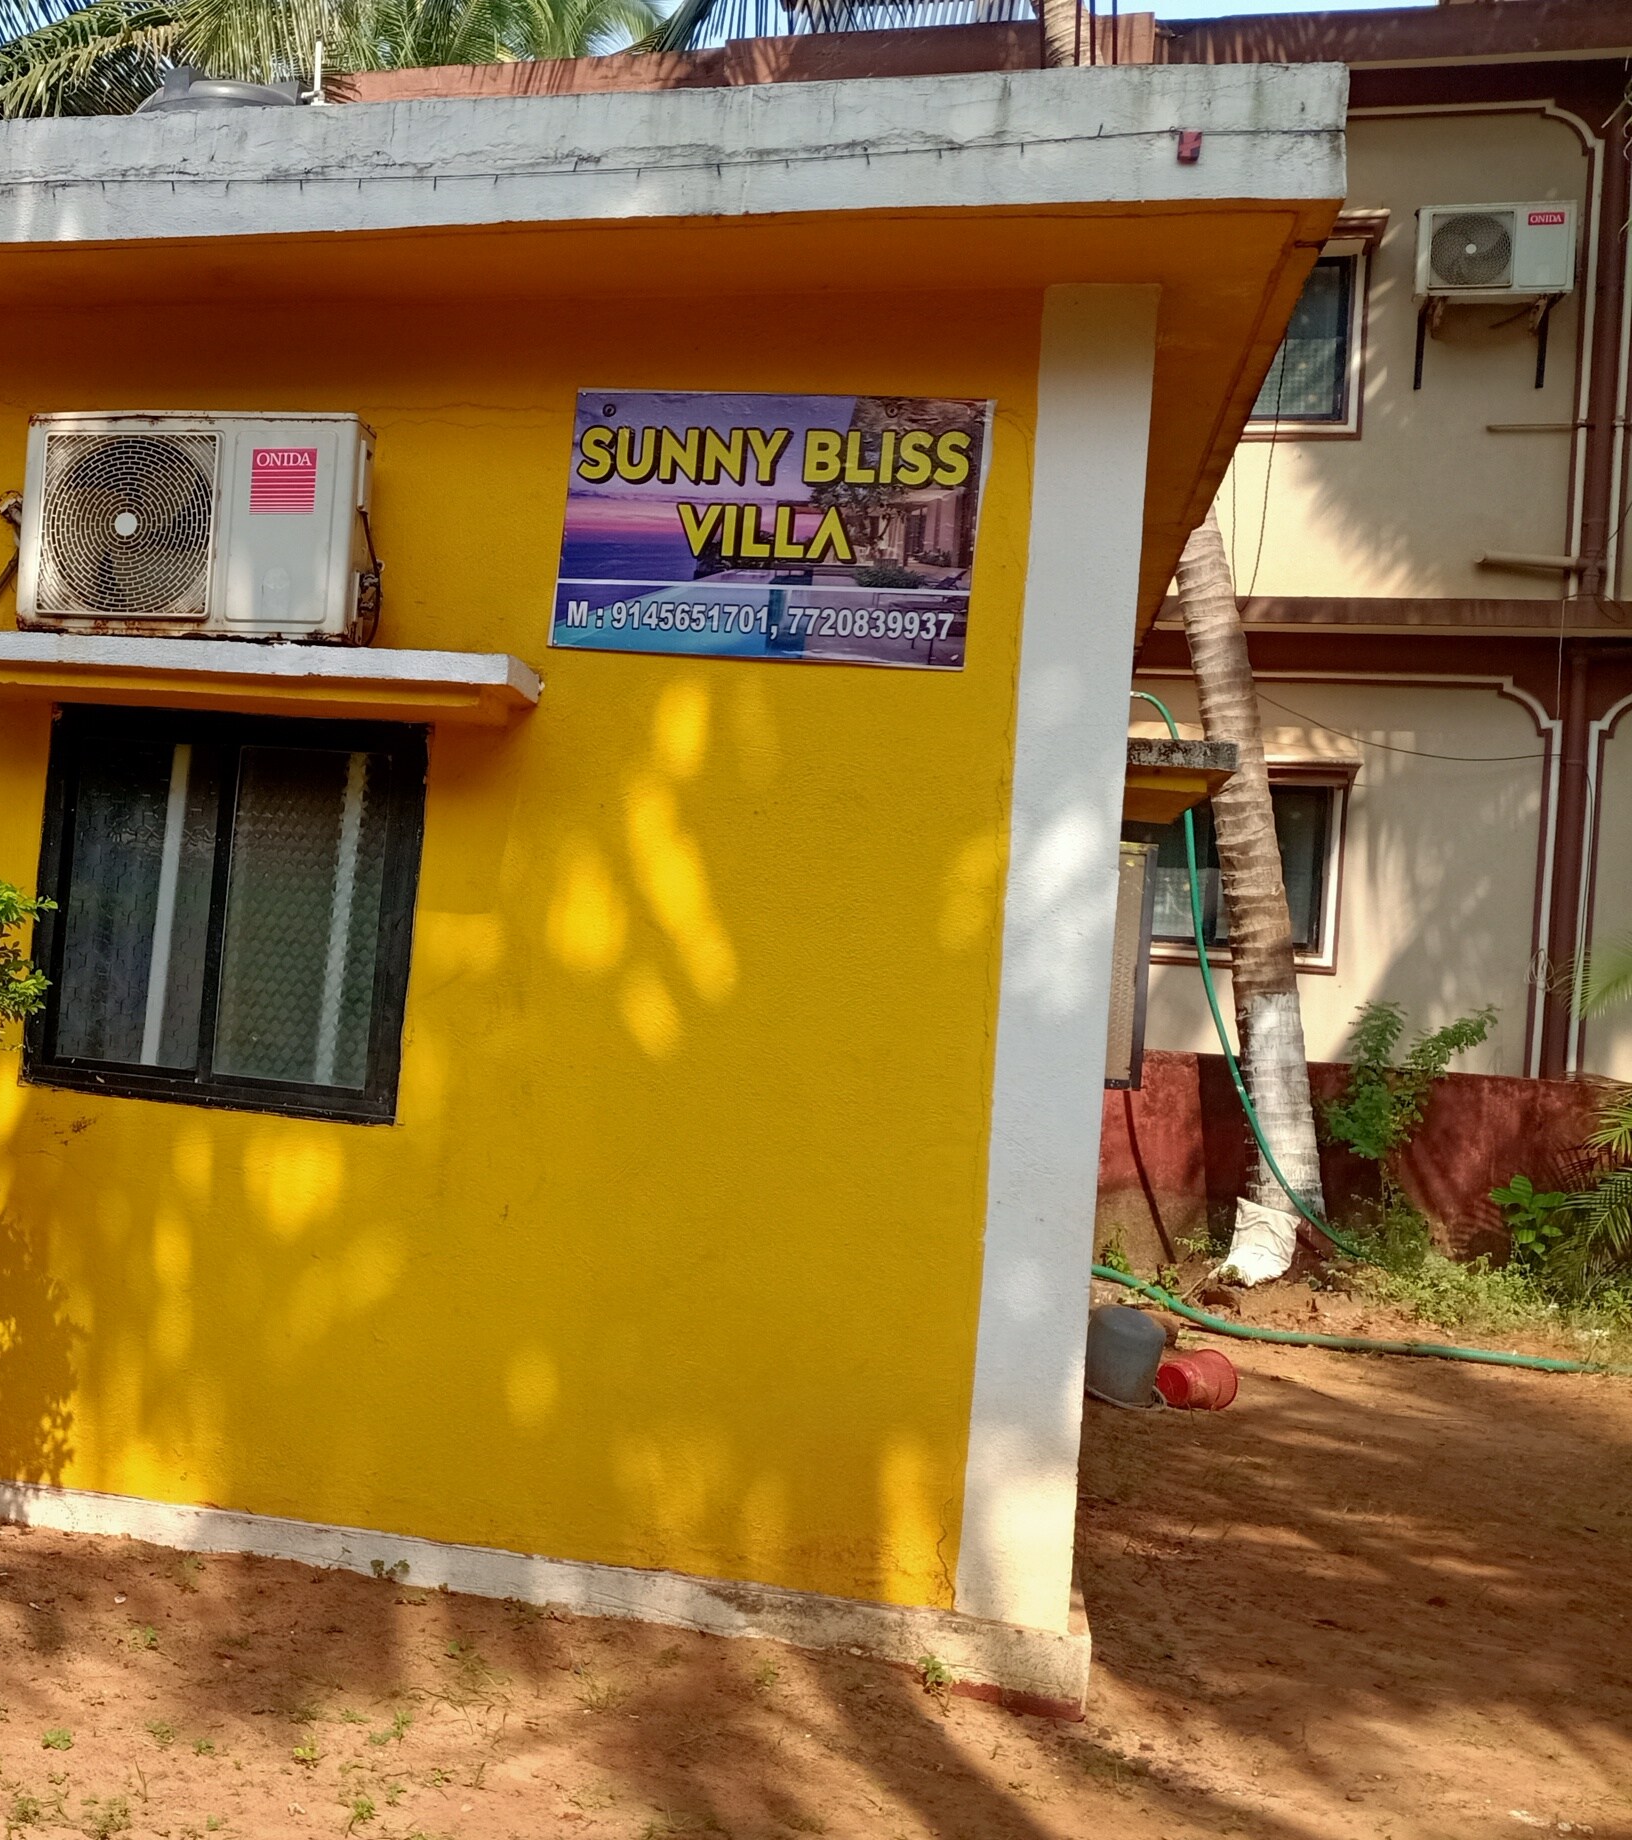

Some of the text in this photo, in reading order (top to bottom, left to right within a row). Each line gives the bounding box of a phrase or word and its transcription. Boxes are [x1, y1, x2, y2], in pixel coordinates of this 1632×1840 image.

[1530, 214, 1562, 224] ONIDA
[256, 452, 313, 467] ONIDA
[578, 425, 970, 486] SUNNY BLISS
[677, 502, 854, 562] VILLA
[610, 601, 778, 640] 9145651701,
[788, 606, 955, 641] 7720839937
